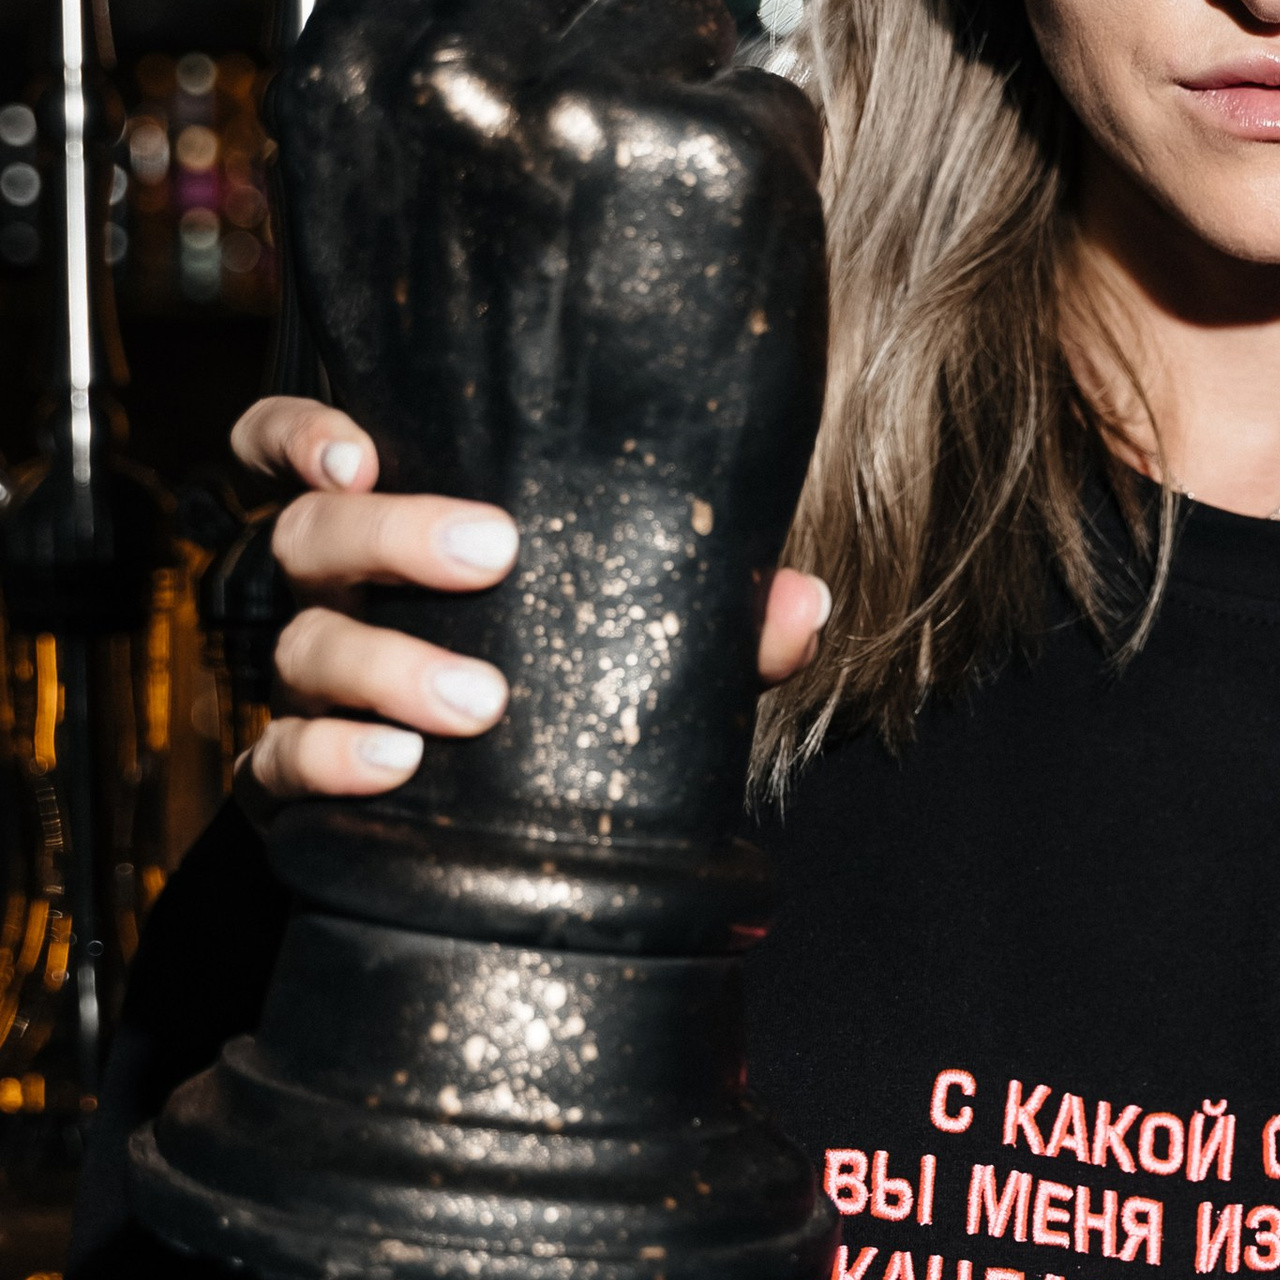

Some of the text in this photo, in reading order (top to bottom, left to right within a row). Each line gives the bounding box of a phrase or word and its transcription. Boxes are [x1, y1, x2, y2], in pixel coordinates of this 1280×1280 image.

[929, 1068, 978, 1134] С
[1002, 1079, 1237, 1183] КАКОЙ
[822, 1148, 938, 1227] ВЫ
[966, 1163, 1165, 1267] МЕНЯ
